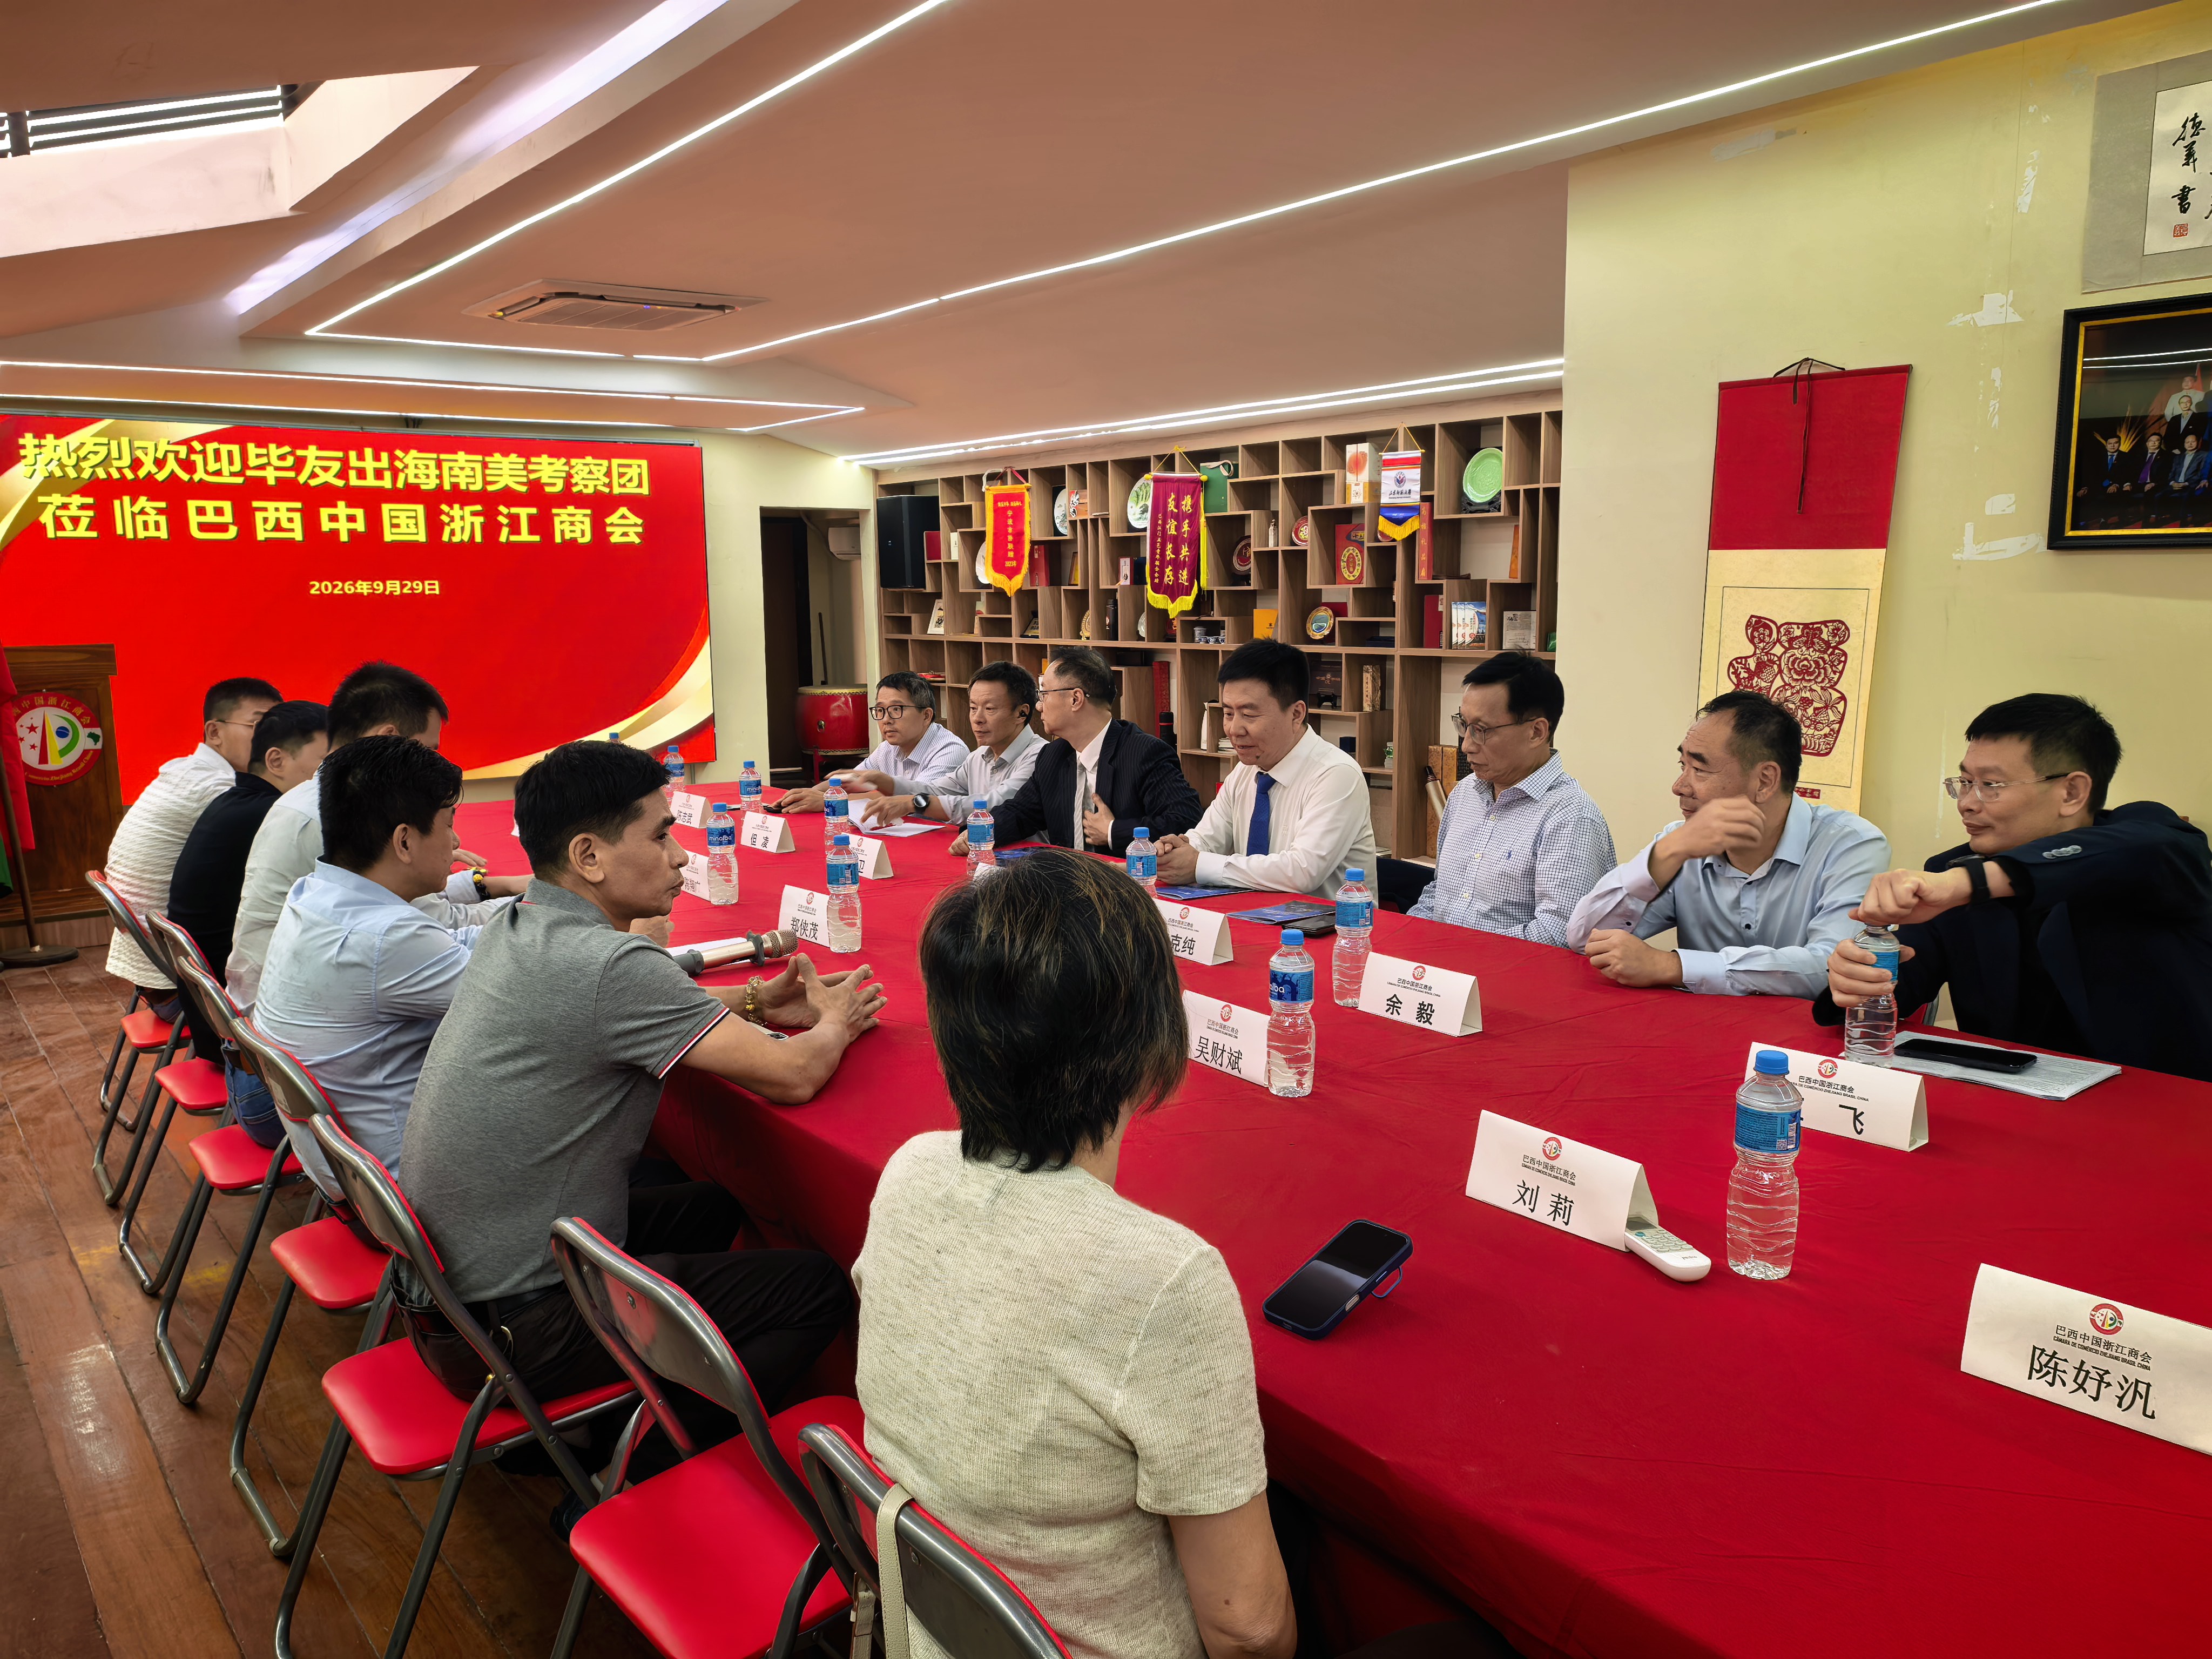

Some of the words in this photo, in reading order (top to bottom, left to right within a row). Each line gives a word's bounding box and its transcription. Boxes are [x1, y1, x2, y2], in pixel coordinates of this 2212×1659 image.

[18, 433, 650, 496] 热烈欢迎毕友出海南美考察团
[37, 493, 644, 544] 莅临巴西中国浙江商会
[1178, 494, 1192, 585] 携手共进
[309, 579, 441, 595] 2026年9月29日
[791, 916, 818, 941] 郑侠茂
[1397, 977, 1433, 992] 巴西中国浙江商会
[1195, 1036, 1243, 1075] 吴财斌
[1799, 1075, 1854, 1094] 巴西中国浙江商会
[1523, 1154, 1576, 1181] 巴西中国浙江商会
[2056, 1324, 2153, 1364] 巴西中国浙江商会
[2027, 1344, 2156, 1419] 陈妤汎
